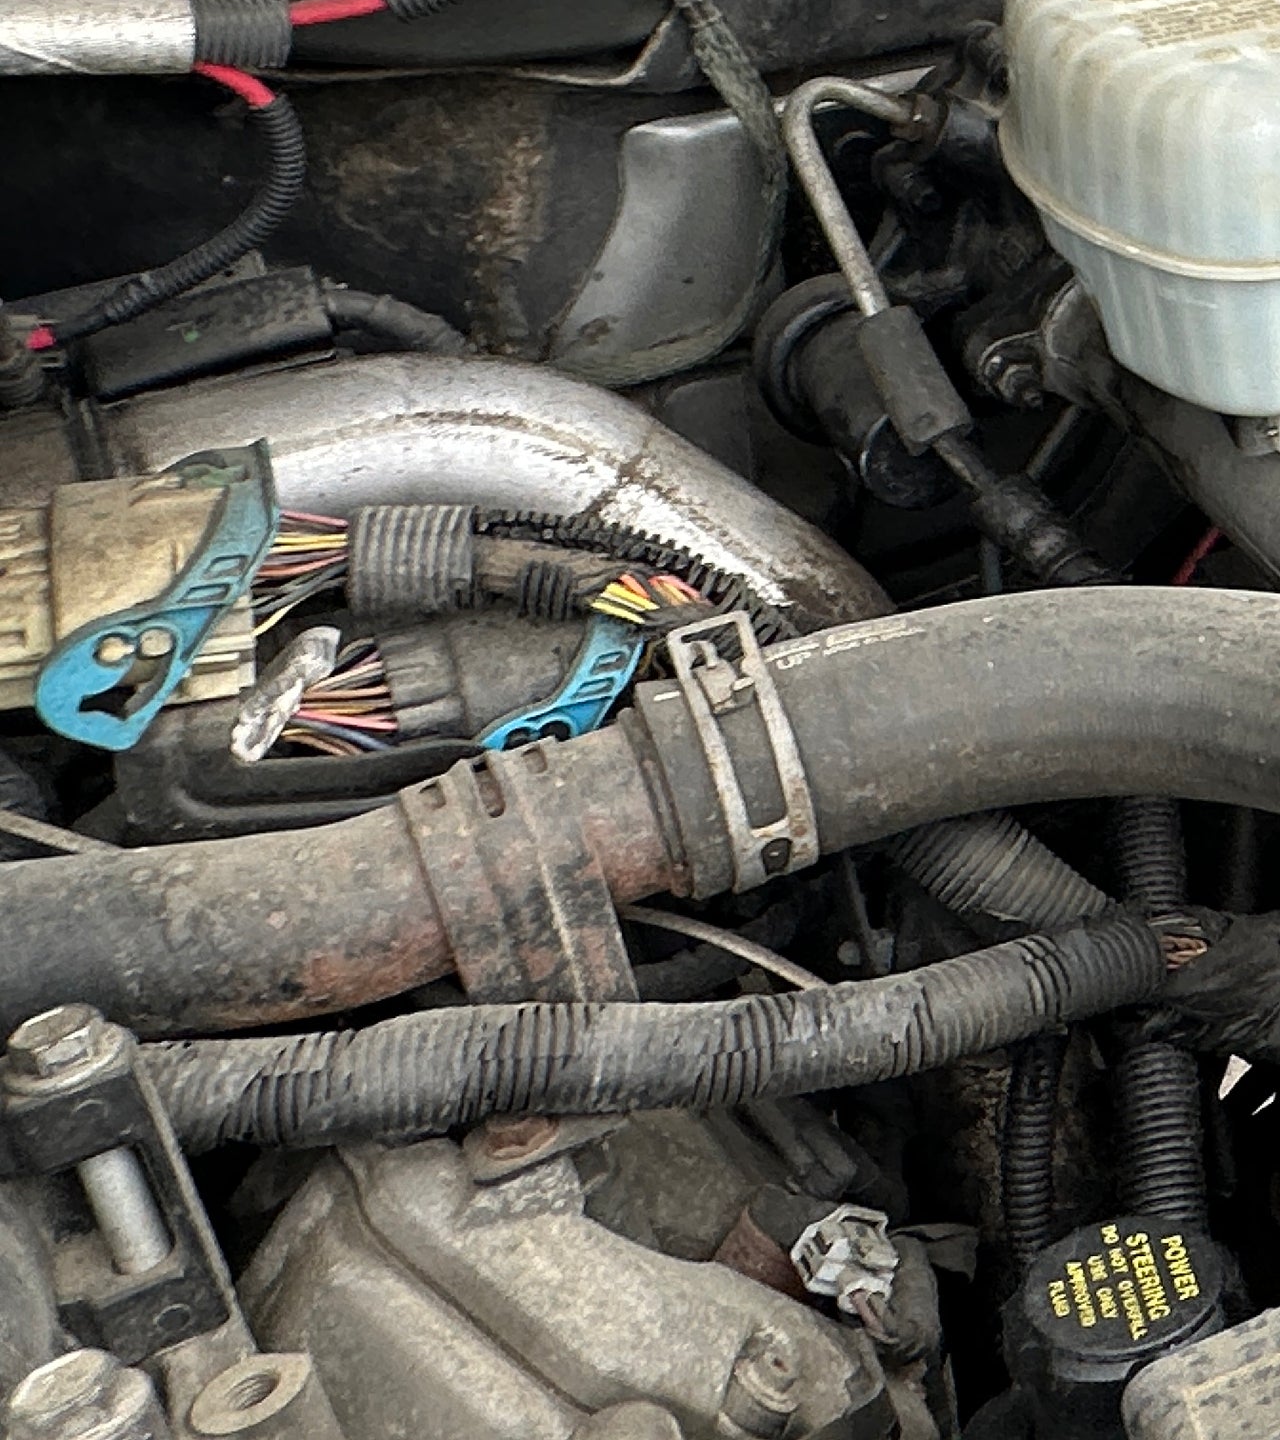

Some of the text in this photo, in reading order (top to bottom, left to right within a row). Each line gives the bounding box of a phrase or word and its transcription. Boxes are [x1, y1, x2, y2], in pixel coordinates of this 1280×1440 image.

[1101, 1224, 1119, 1244] DO
[1109, 1247, 1128, 1273] NOT
[1125, 1232, 1171, 1321] STEERING
[1160, 1234, 1200, 1301] POWER
[1048, 1281, 1070, 1317] FLUID
[1097, 1287, 1119, 1318] ONLY
